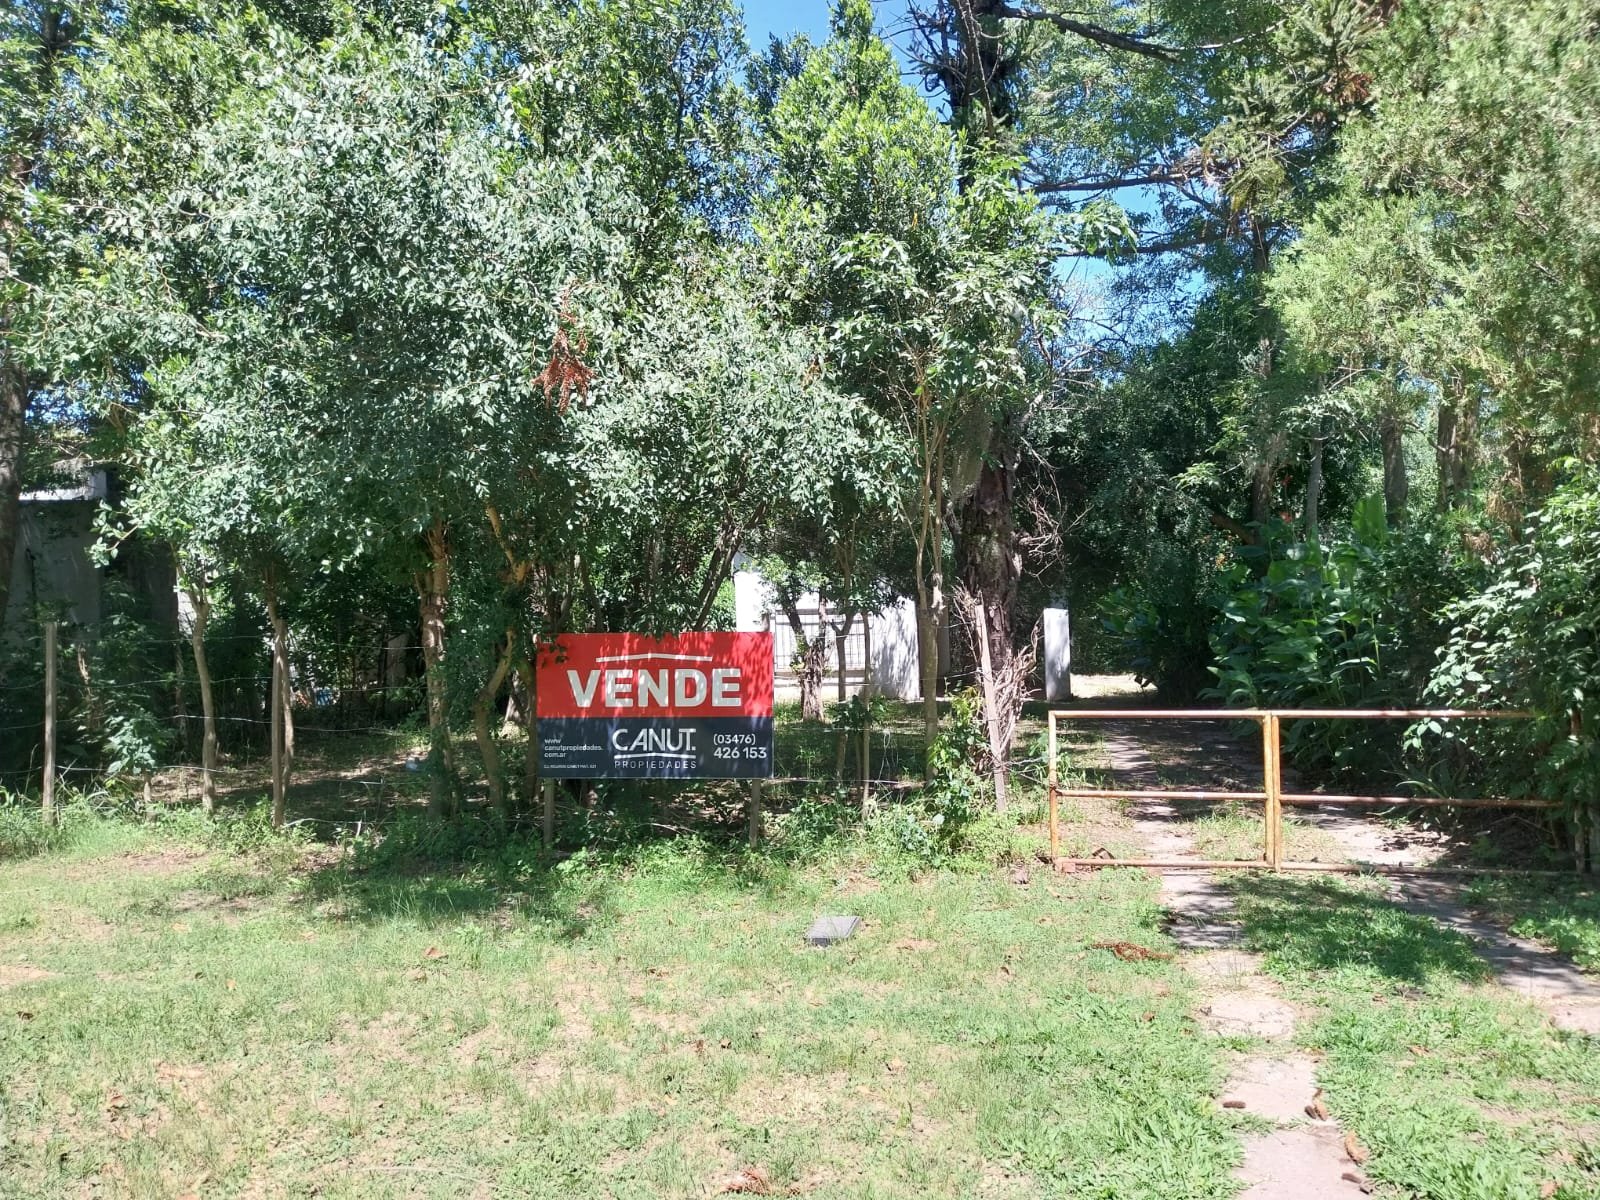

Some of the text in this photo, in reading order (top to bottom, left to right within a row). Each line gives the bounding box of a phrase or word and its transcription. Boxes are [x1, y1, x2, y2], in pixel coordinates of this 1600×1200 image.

[566, 668, 742, 707] VENDE
[713, 733, 756, 746] (03476)
[713, 747, 767, 759] 426 153
[614, 760, 697, 769] PROPIEDADES
